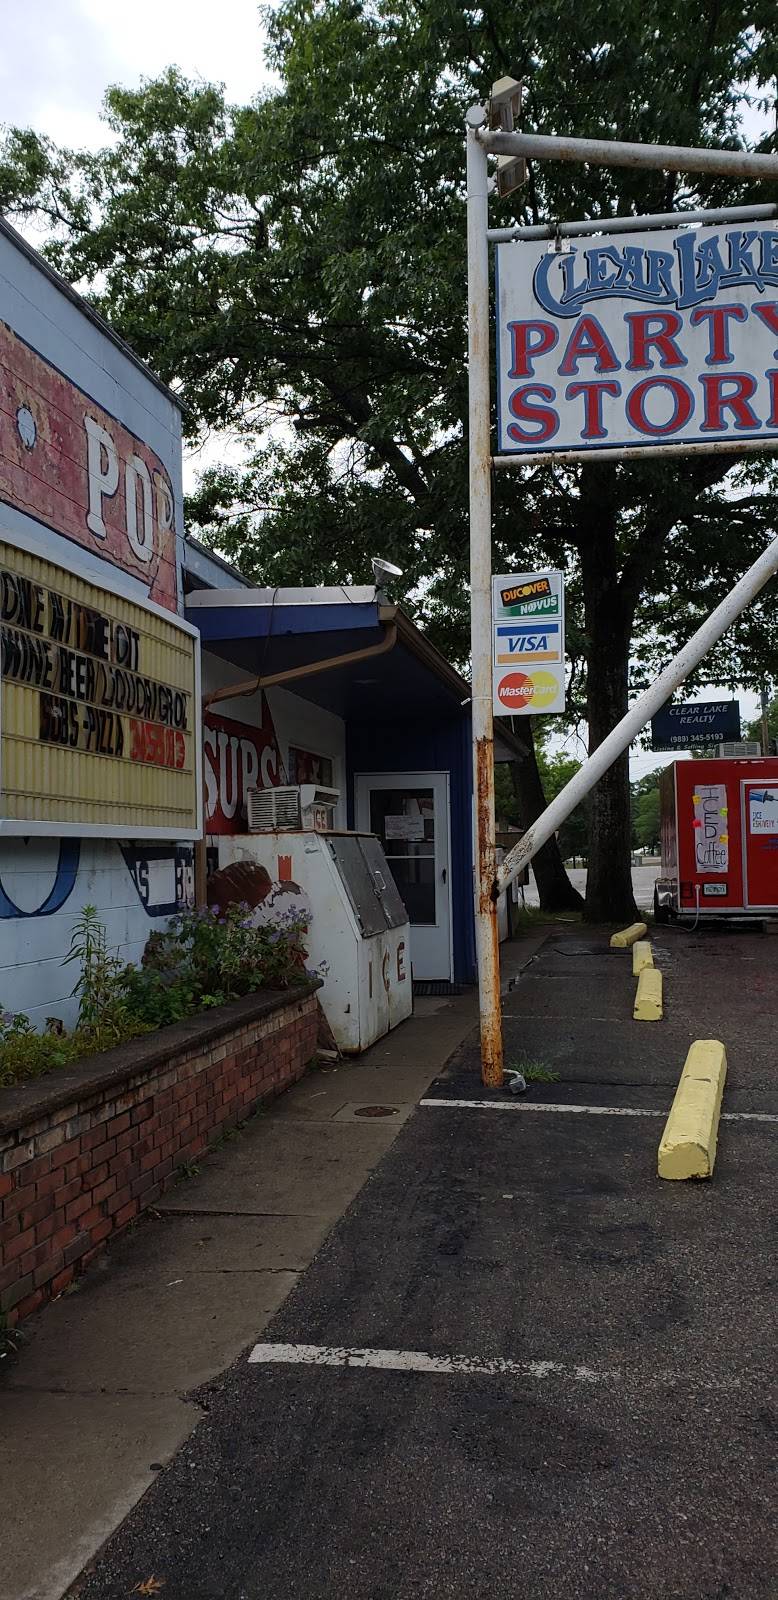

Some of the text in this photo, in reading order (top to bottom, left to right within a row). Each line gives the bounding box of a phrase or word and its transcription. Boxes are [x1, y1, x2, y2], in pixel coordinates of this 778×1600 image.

[507, 368, 778, 444] STOR
[502, 580, 549, 602] DISCOVER
[508, 635, 549, 652] VISA
[499, 683, 557, 697] MasterCard
[669, 704, 729, 717] CLEAR LAKE
[680, 714, 716, 724] REALTY
